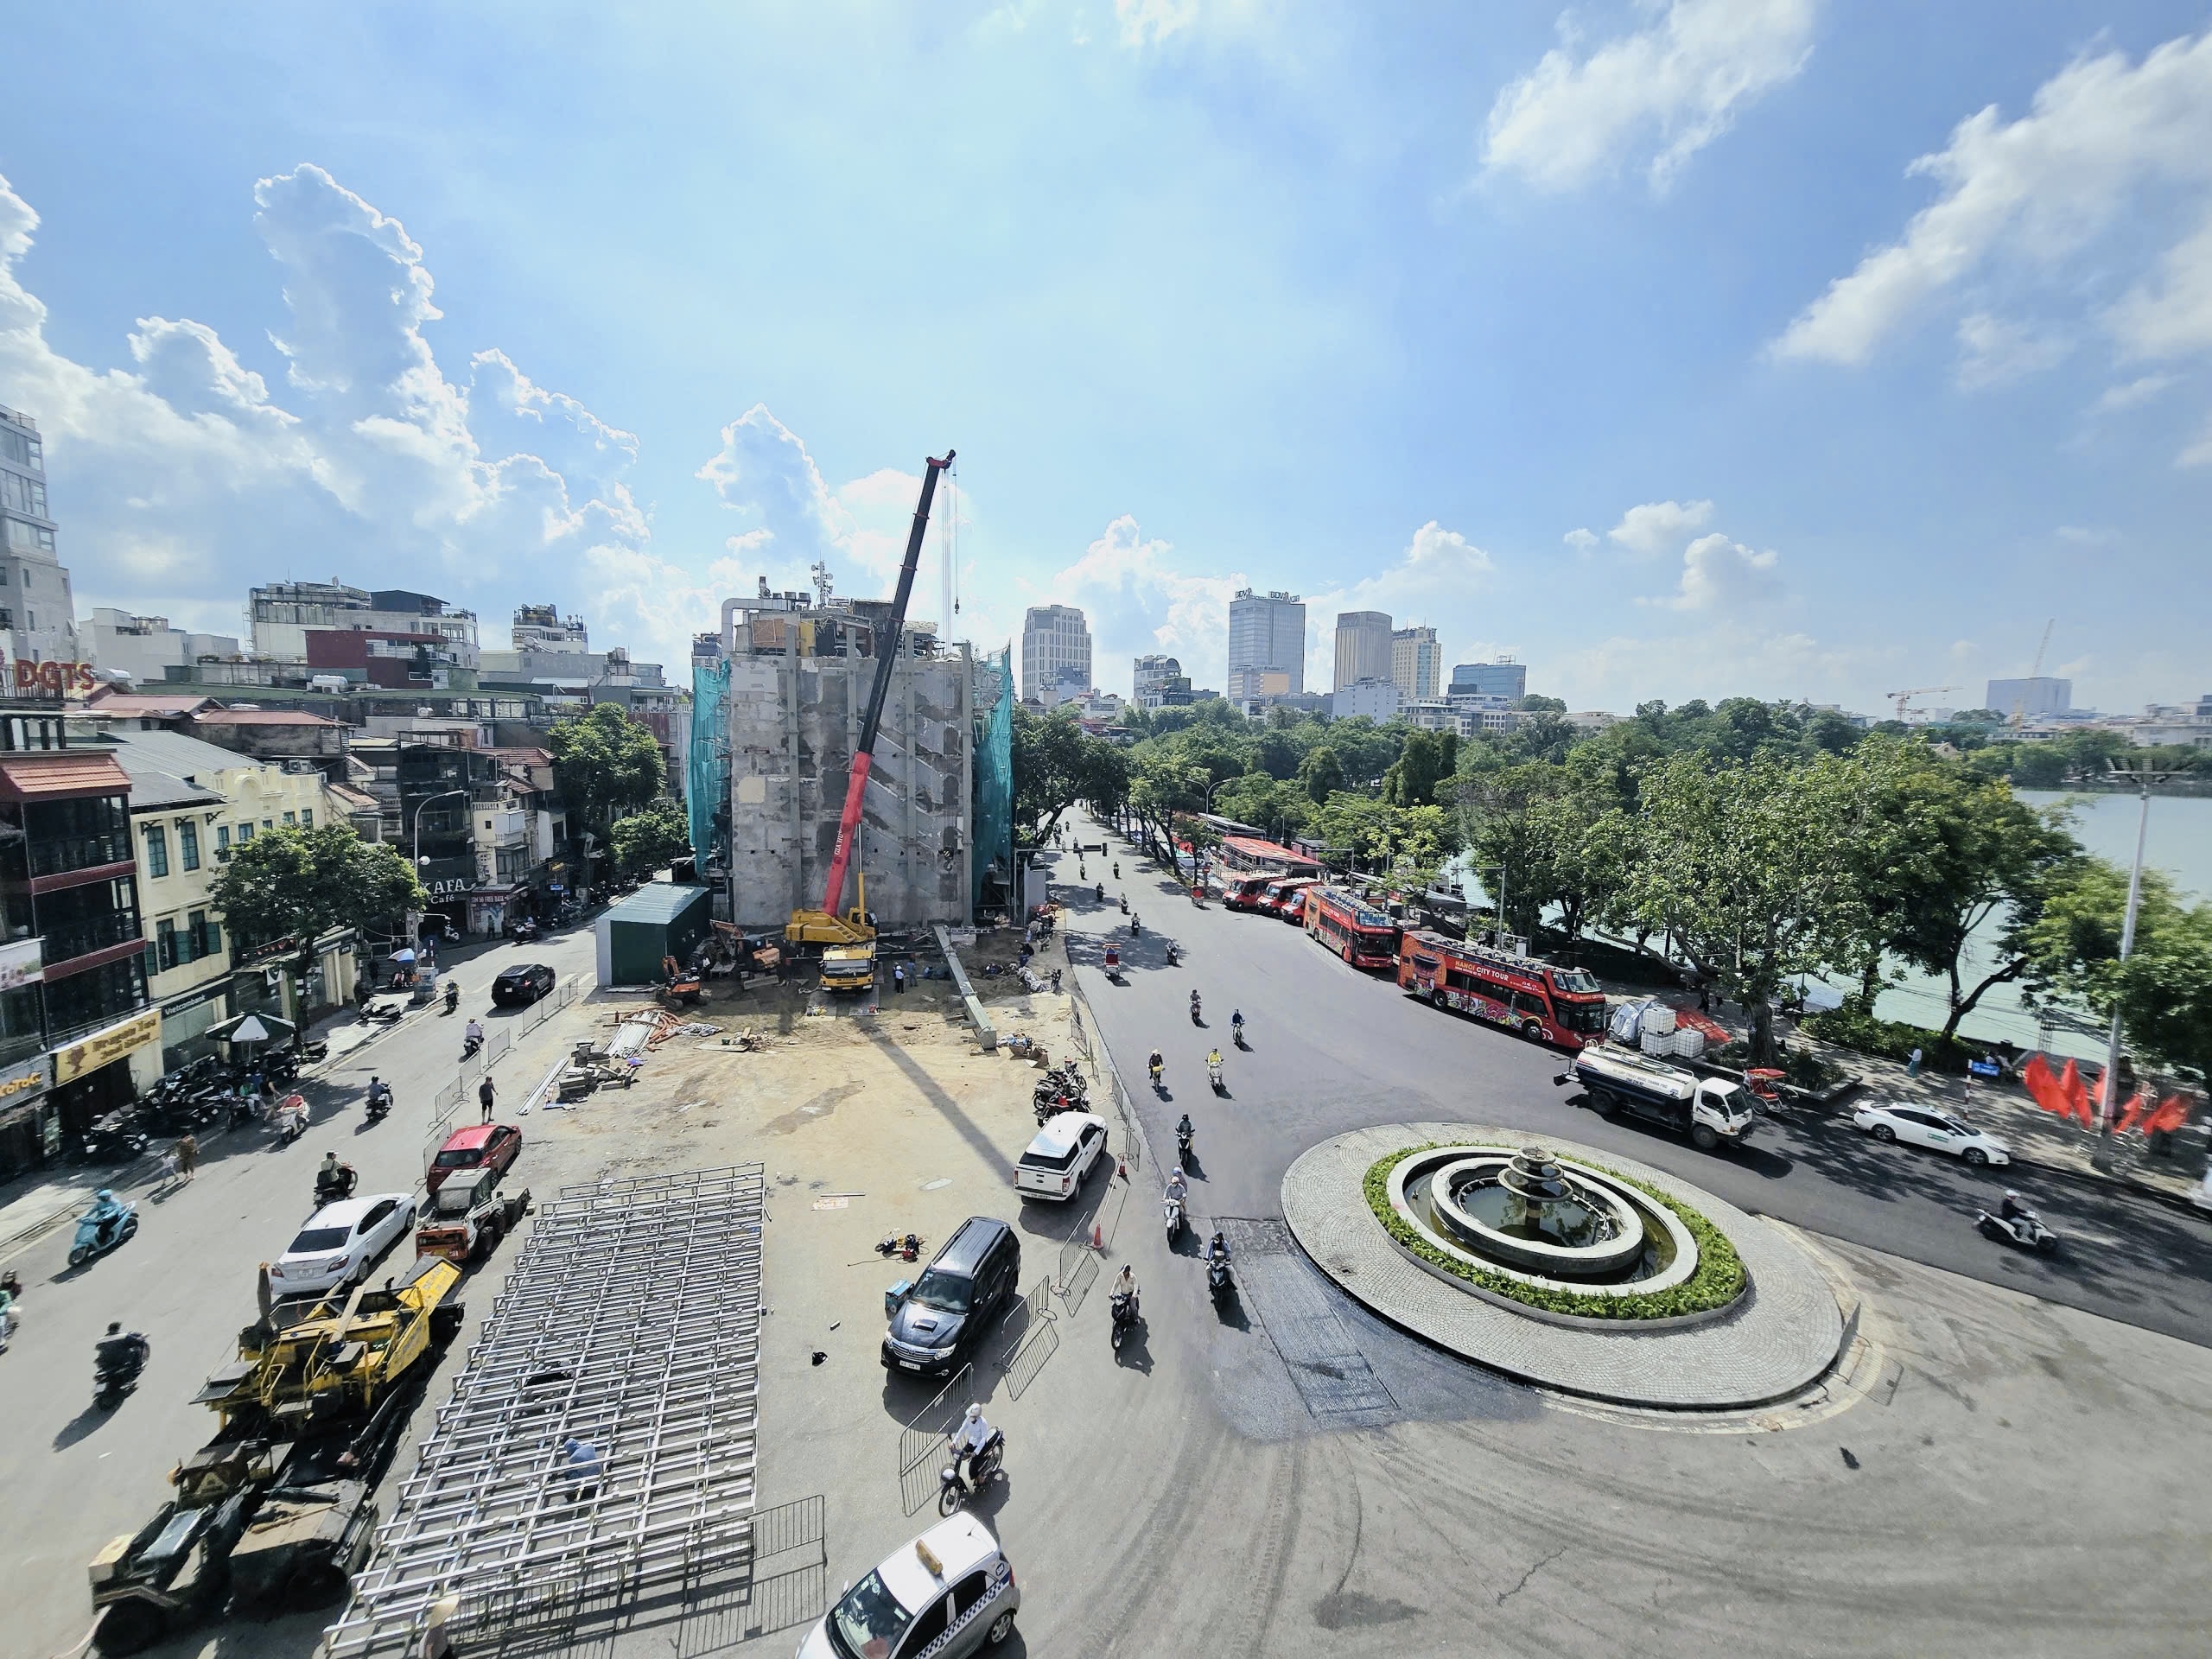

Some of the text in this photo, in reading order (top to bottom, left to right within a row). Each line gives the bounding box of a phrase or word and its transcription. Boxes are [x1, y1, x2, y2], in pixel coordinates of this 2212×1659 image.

[14, 658, 94, 690] DGTS
[431, 893, 454, 905] Café
[1455, 960, 1475, 970] HANOI
[1476, 966, 1491, 976] CITY
[1491, 970, 1510, 982] TOUR
[164, 993, 207, 1015] Vietcombank
